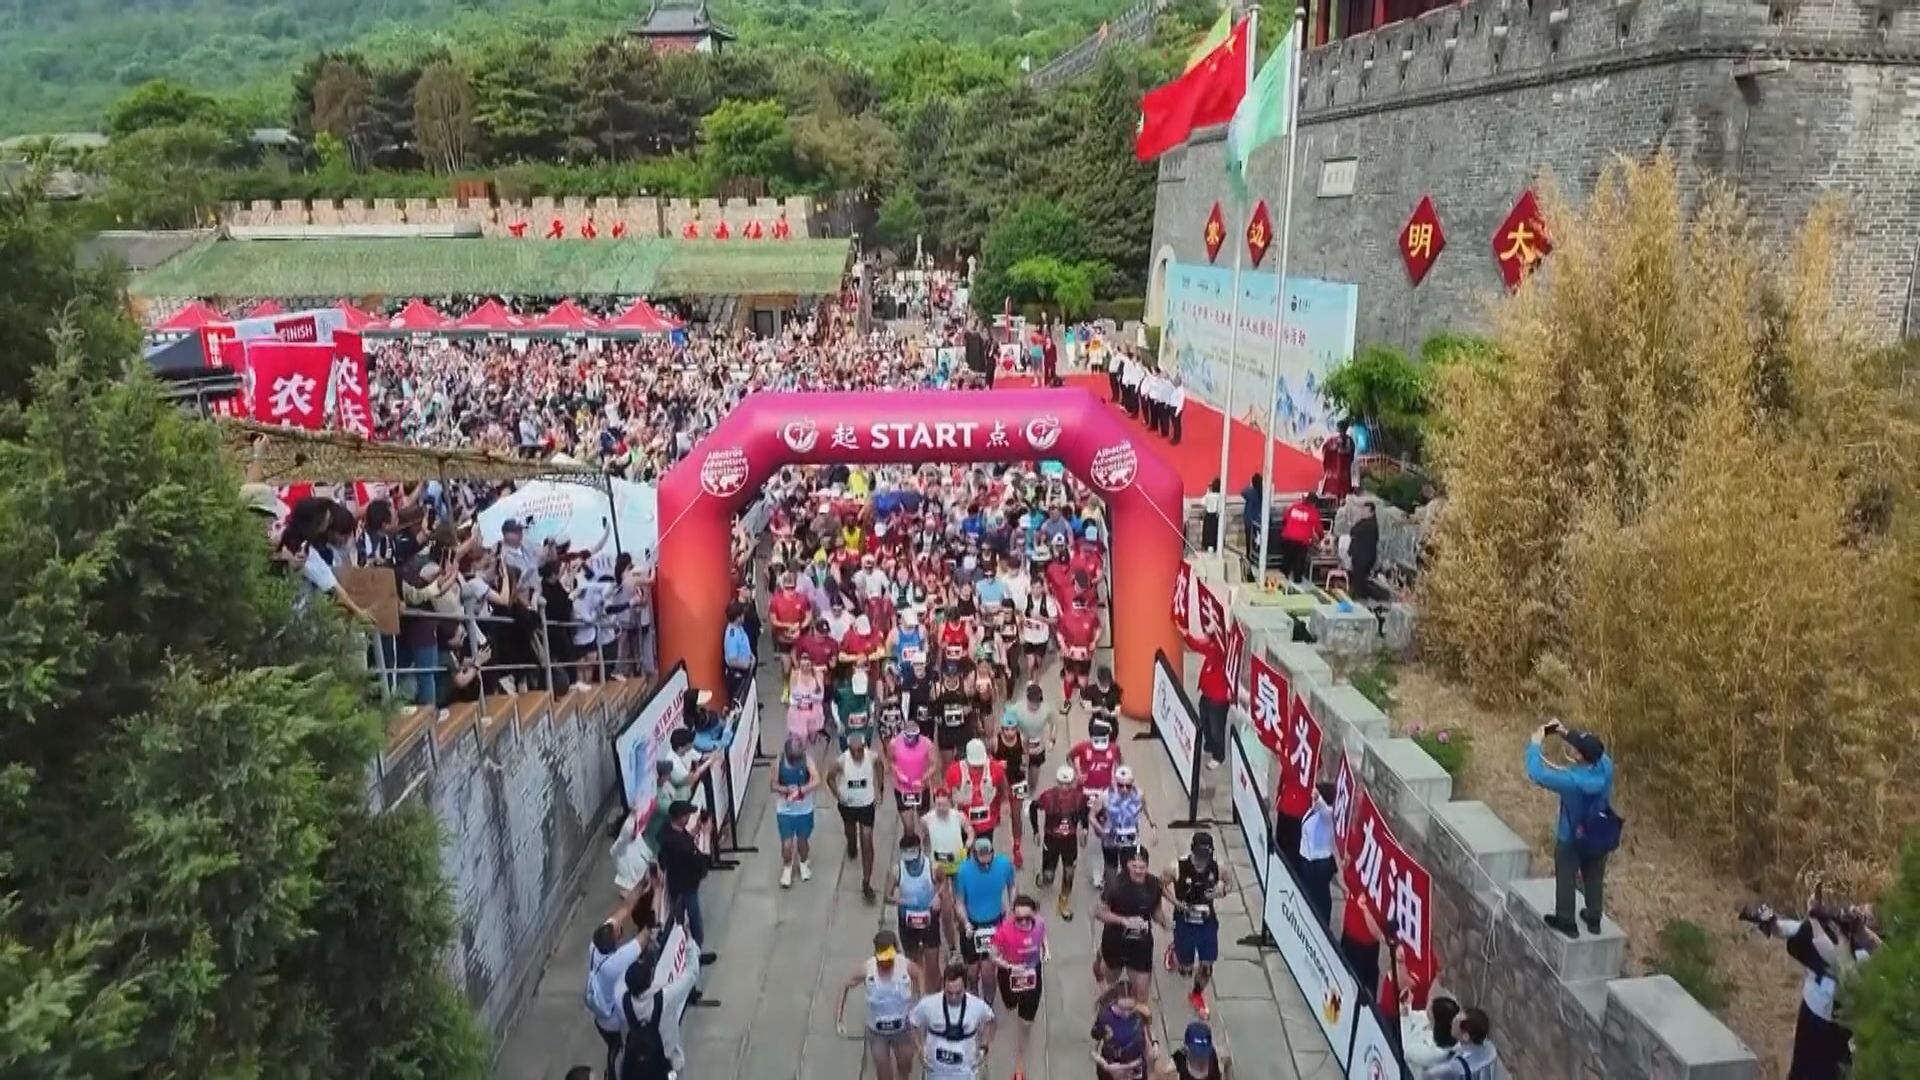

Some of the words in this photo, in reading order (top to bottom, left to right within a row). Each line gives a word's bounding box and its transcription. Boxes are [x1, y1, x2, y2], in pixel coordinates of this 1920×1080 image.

[1249, 220, 1264, 248] 边
[1408, 223, 1433, 259] 明
[1499, 221, 1537, 263] 大
[268, 372, 317, 416] 农
[831, 424, 860, 449] 起
[871, 422, 979, 449] START
[986, 419, 1009, 448] 点
[1290, 714, 1314, 788] 为
[1355, 814, 1422, 960] 加油
